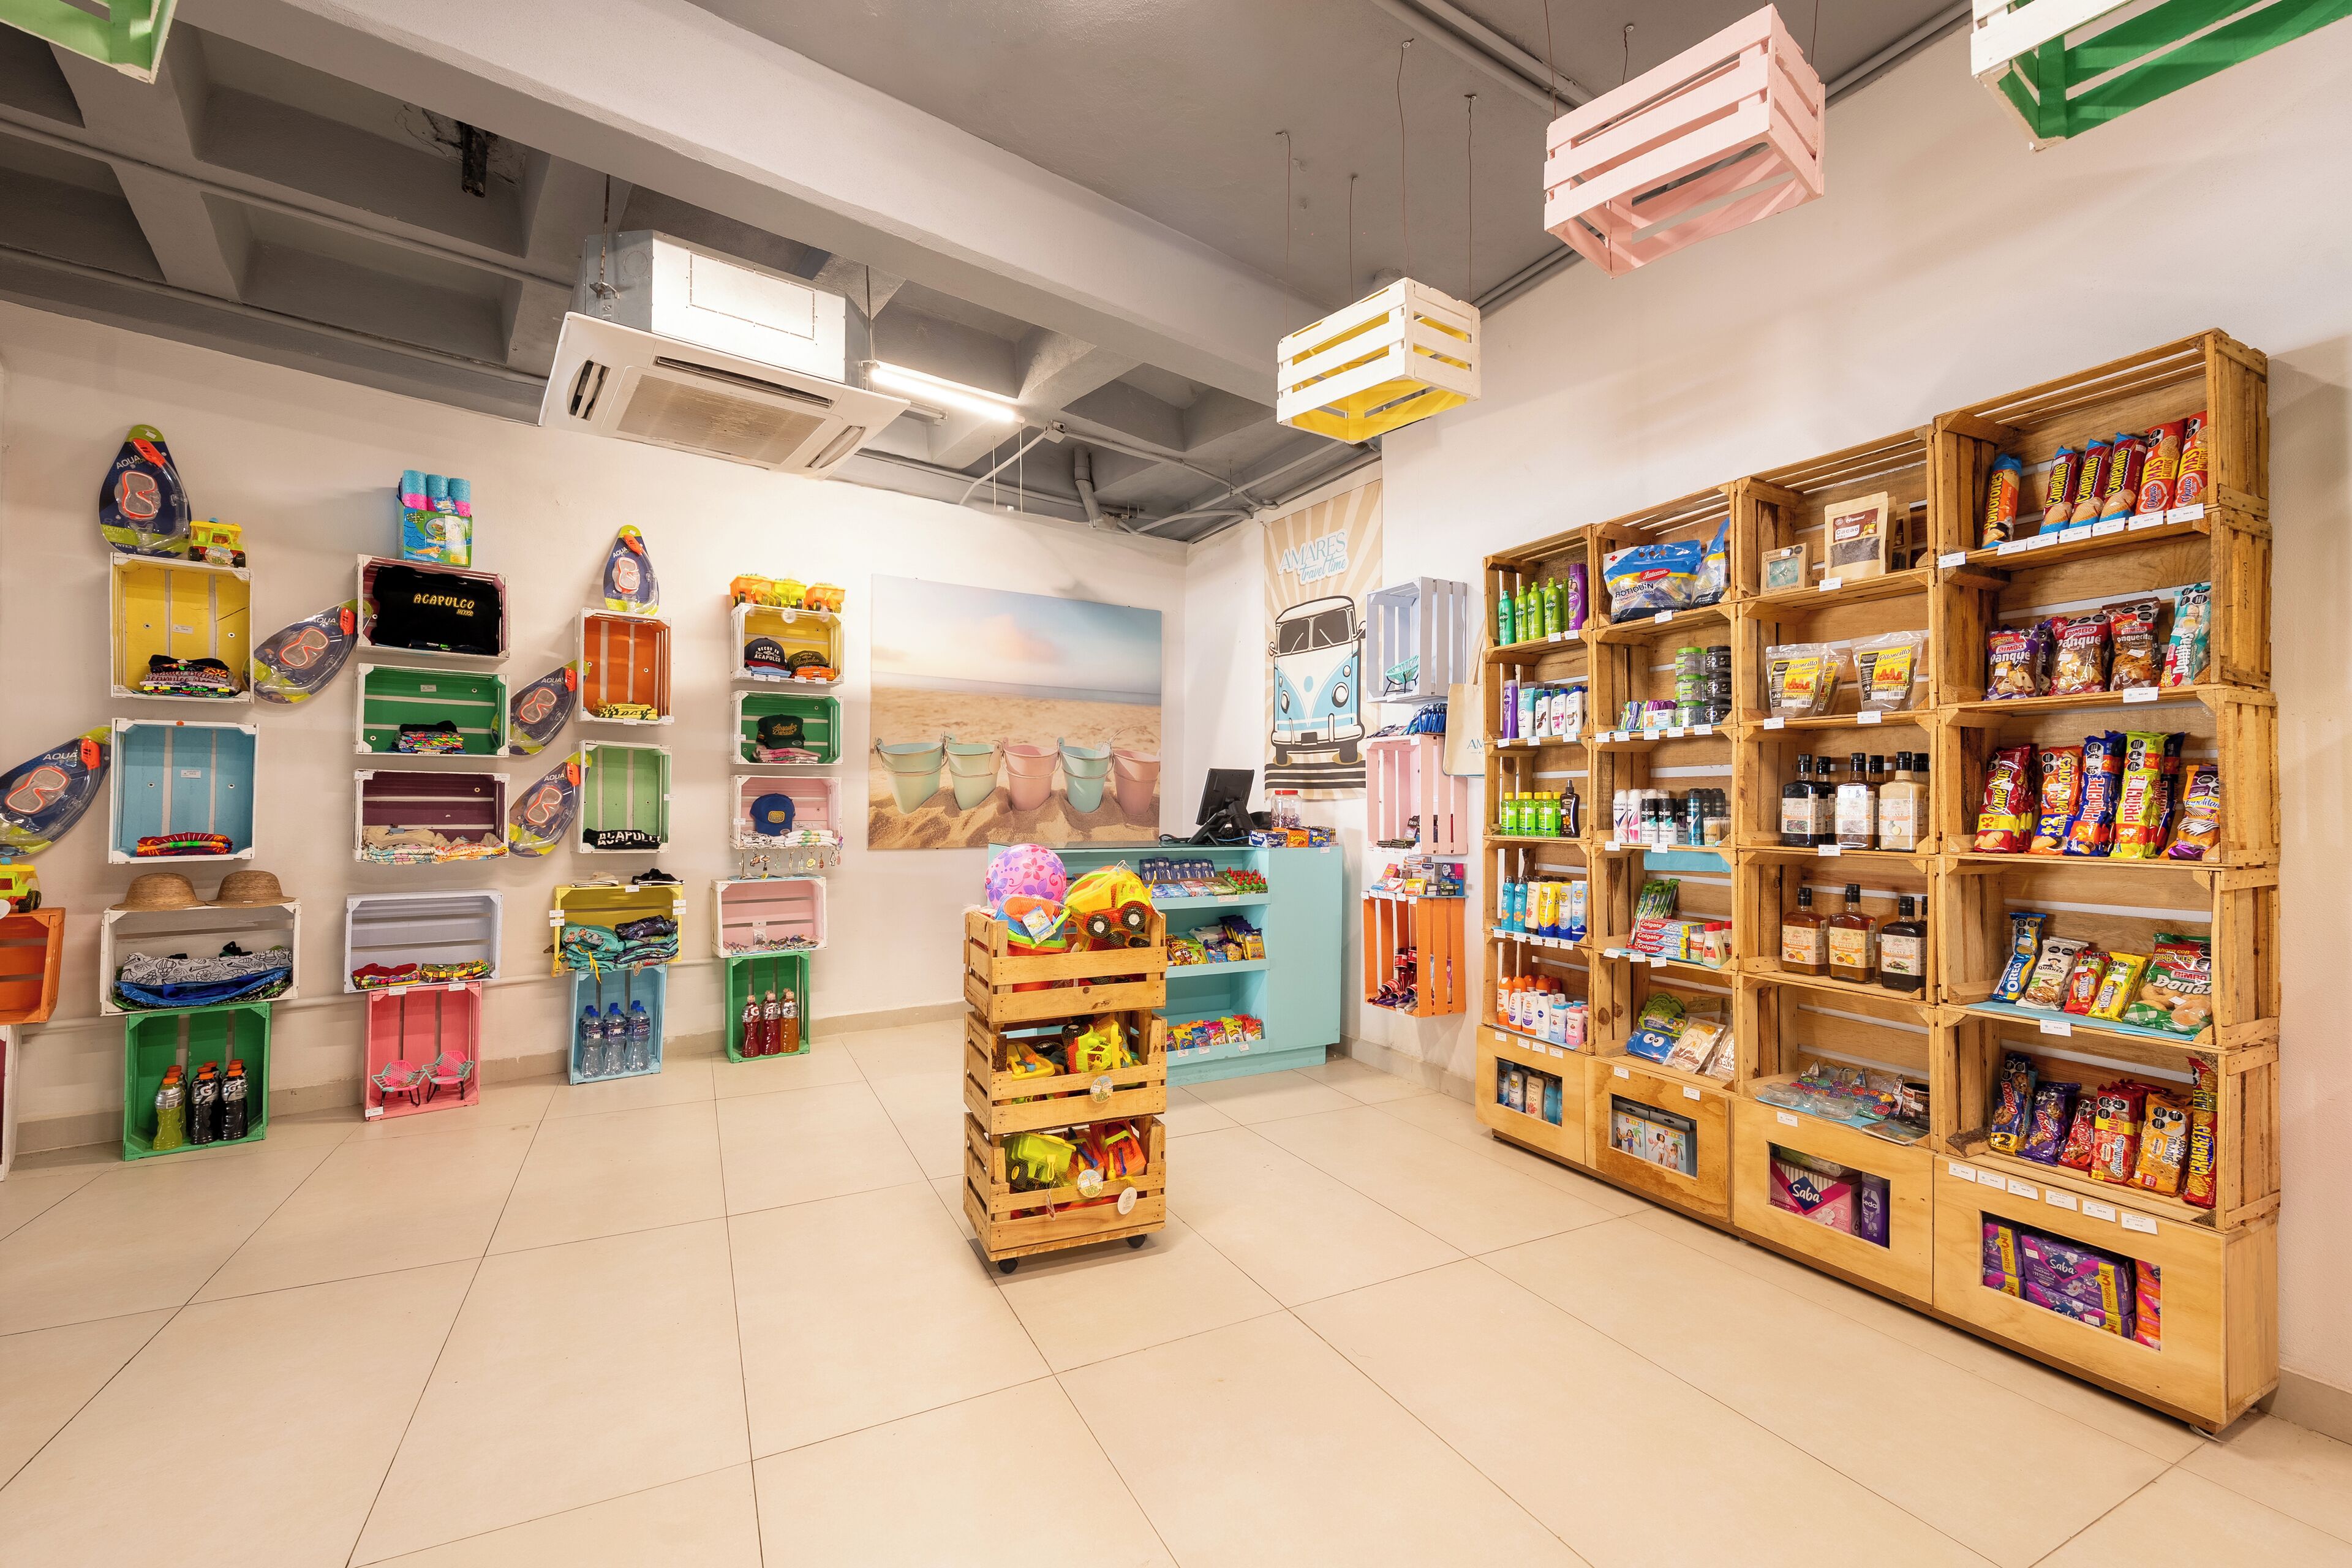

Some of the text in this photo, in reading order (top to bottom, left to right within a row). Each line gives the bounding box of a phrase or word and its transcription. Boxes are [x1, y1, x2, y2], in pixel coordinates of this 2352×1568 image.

[116, 455, 141, 470] AQUA
[2046, 463, 2068, 507] Canelitas
[1983, 471, 2004, 529] Polvorones
[103, 525, 124, 533] YOUTH
[1836, 526, 1859, 535] Cacao
[612, 547, 628, 558] AQUA
[1280, 532, 1345, 572] AMARES
[1299, 554, 1346, 581] travel time
[413, 593, 475, 609] ACAPULCO
[1878, 648, 1910, 662] Piloncillo
[1999, 644, 2024, 652] BIMBO
[754, 654, 781, 663] ACAPULCO
[1789, 660, 1819, 671] Piloncillo
[42, 752, 78, 761] AQUA
[544, 773, 565, 782] AQUA
[1981, 816, 1994, 829] +3
[2055, 814, 2068, 836] GALLETAS
[1637, 932, 1660, 940] Colgate
[2038, 965, 2065, 974] QUAKER
[2174, 971, 2207, 981] BIMBO
[2007, 962, 2022, 992] OREO
[2152, 974, 2212, 995] Donas
[200, 1085, 213, 1096] G
[1991, 1133, 2011, 1147] +2
[2163, 1137, 2178, 1164] Barras
[2190, 1122, 2212, 1177] CRACKETS
[1792, 1184, 1822, 1203] Saba
[2002, 1250, 2011, 1270] GRATIS
[2049, 1259, 2075, 1275] Saba
[2104, 1288, 2113, 1310] GRATIS
